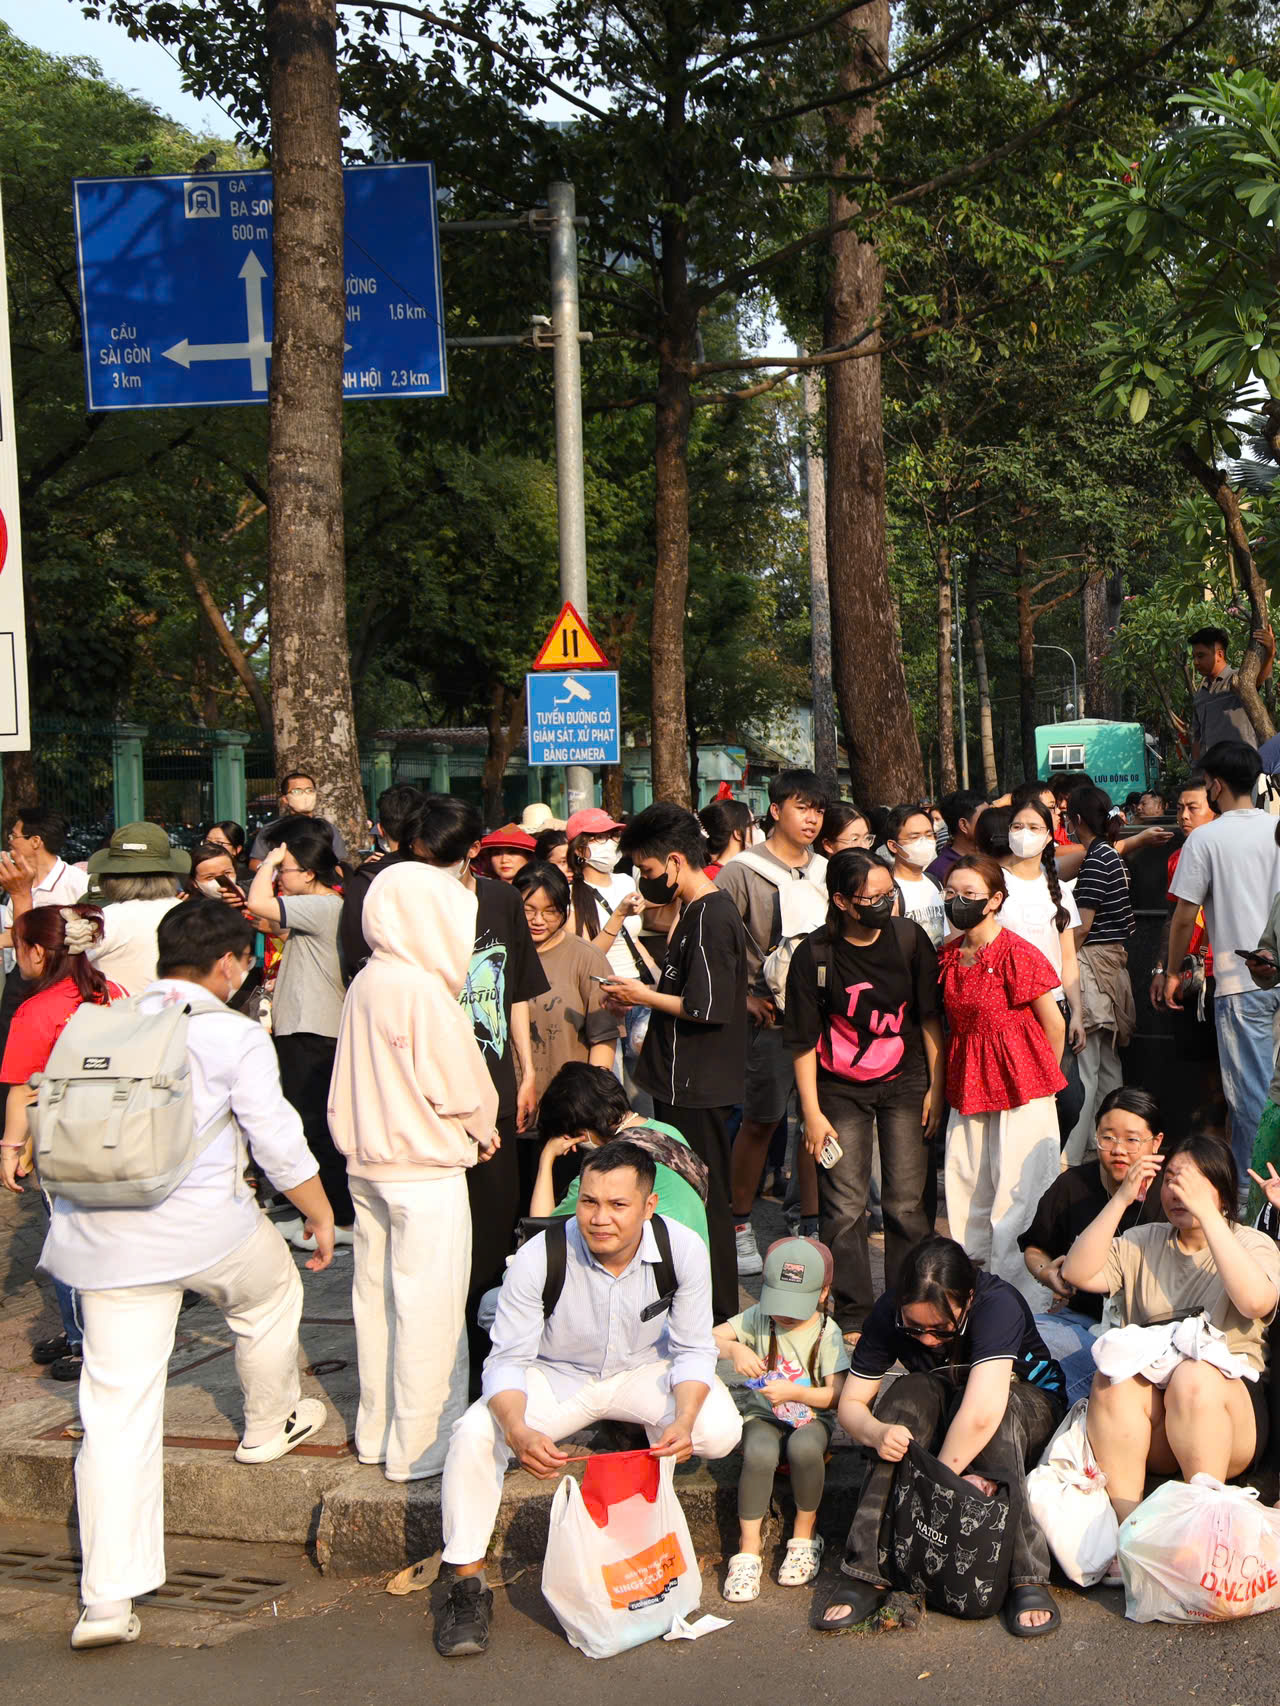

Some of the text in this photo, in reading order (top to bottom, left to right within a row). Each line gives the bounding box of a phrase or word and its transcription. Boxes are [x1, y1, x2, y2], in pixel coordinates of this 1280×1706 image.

[229, 180, 247, 193] GA
[230, 200, 249, 217] BA
[232, 224, 269, 241] 600 m
[406, 303, 427, 320] km
[111, 322, 137, 340] CẦU
[100, 343, 151, 365] SÀI GÒN
[112, 372, 142, 388] 3 km
[360, 367, 381, 391] HỘI
[410, 370, 430, 386] km
[536, 707, 611, 725] TUYẾN ĐƯỜNG CÓ
[533, 727, 555, 743] GIÁM
[577, 725, 590, 742] XỬ
[591, 729, 615, 745] PHẠT
[544, 743, 606, 762] BẰNG CAMERA
[1109, 773, 1129, 784] ĐỘNG
[915, 1519, 949, 1545] NATOLI
